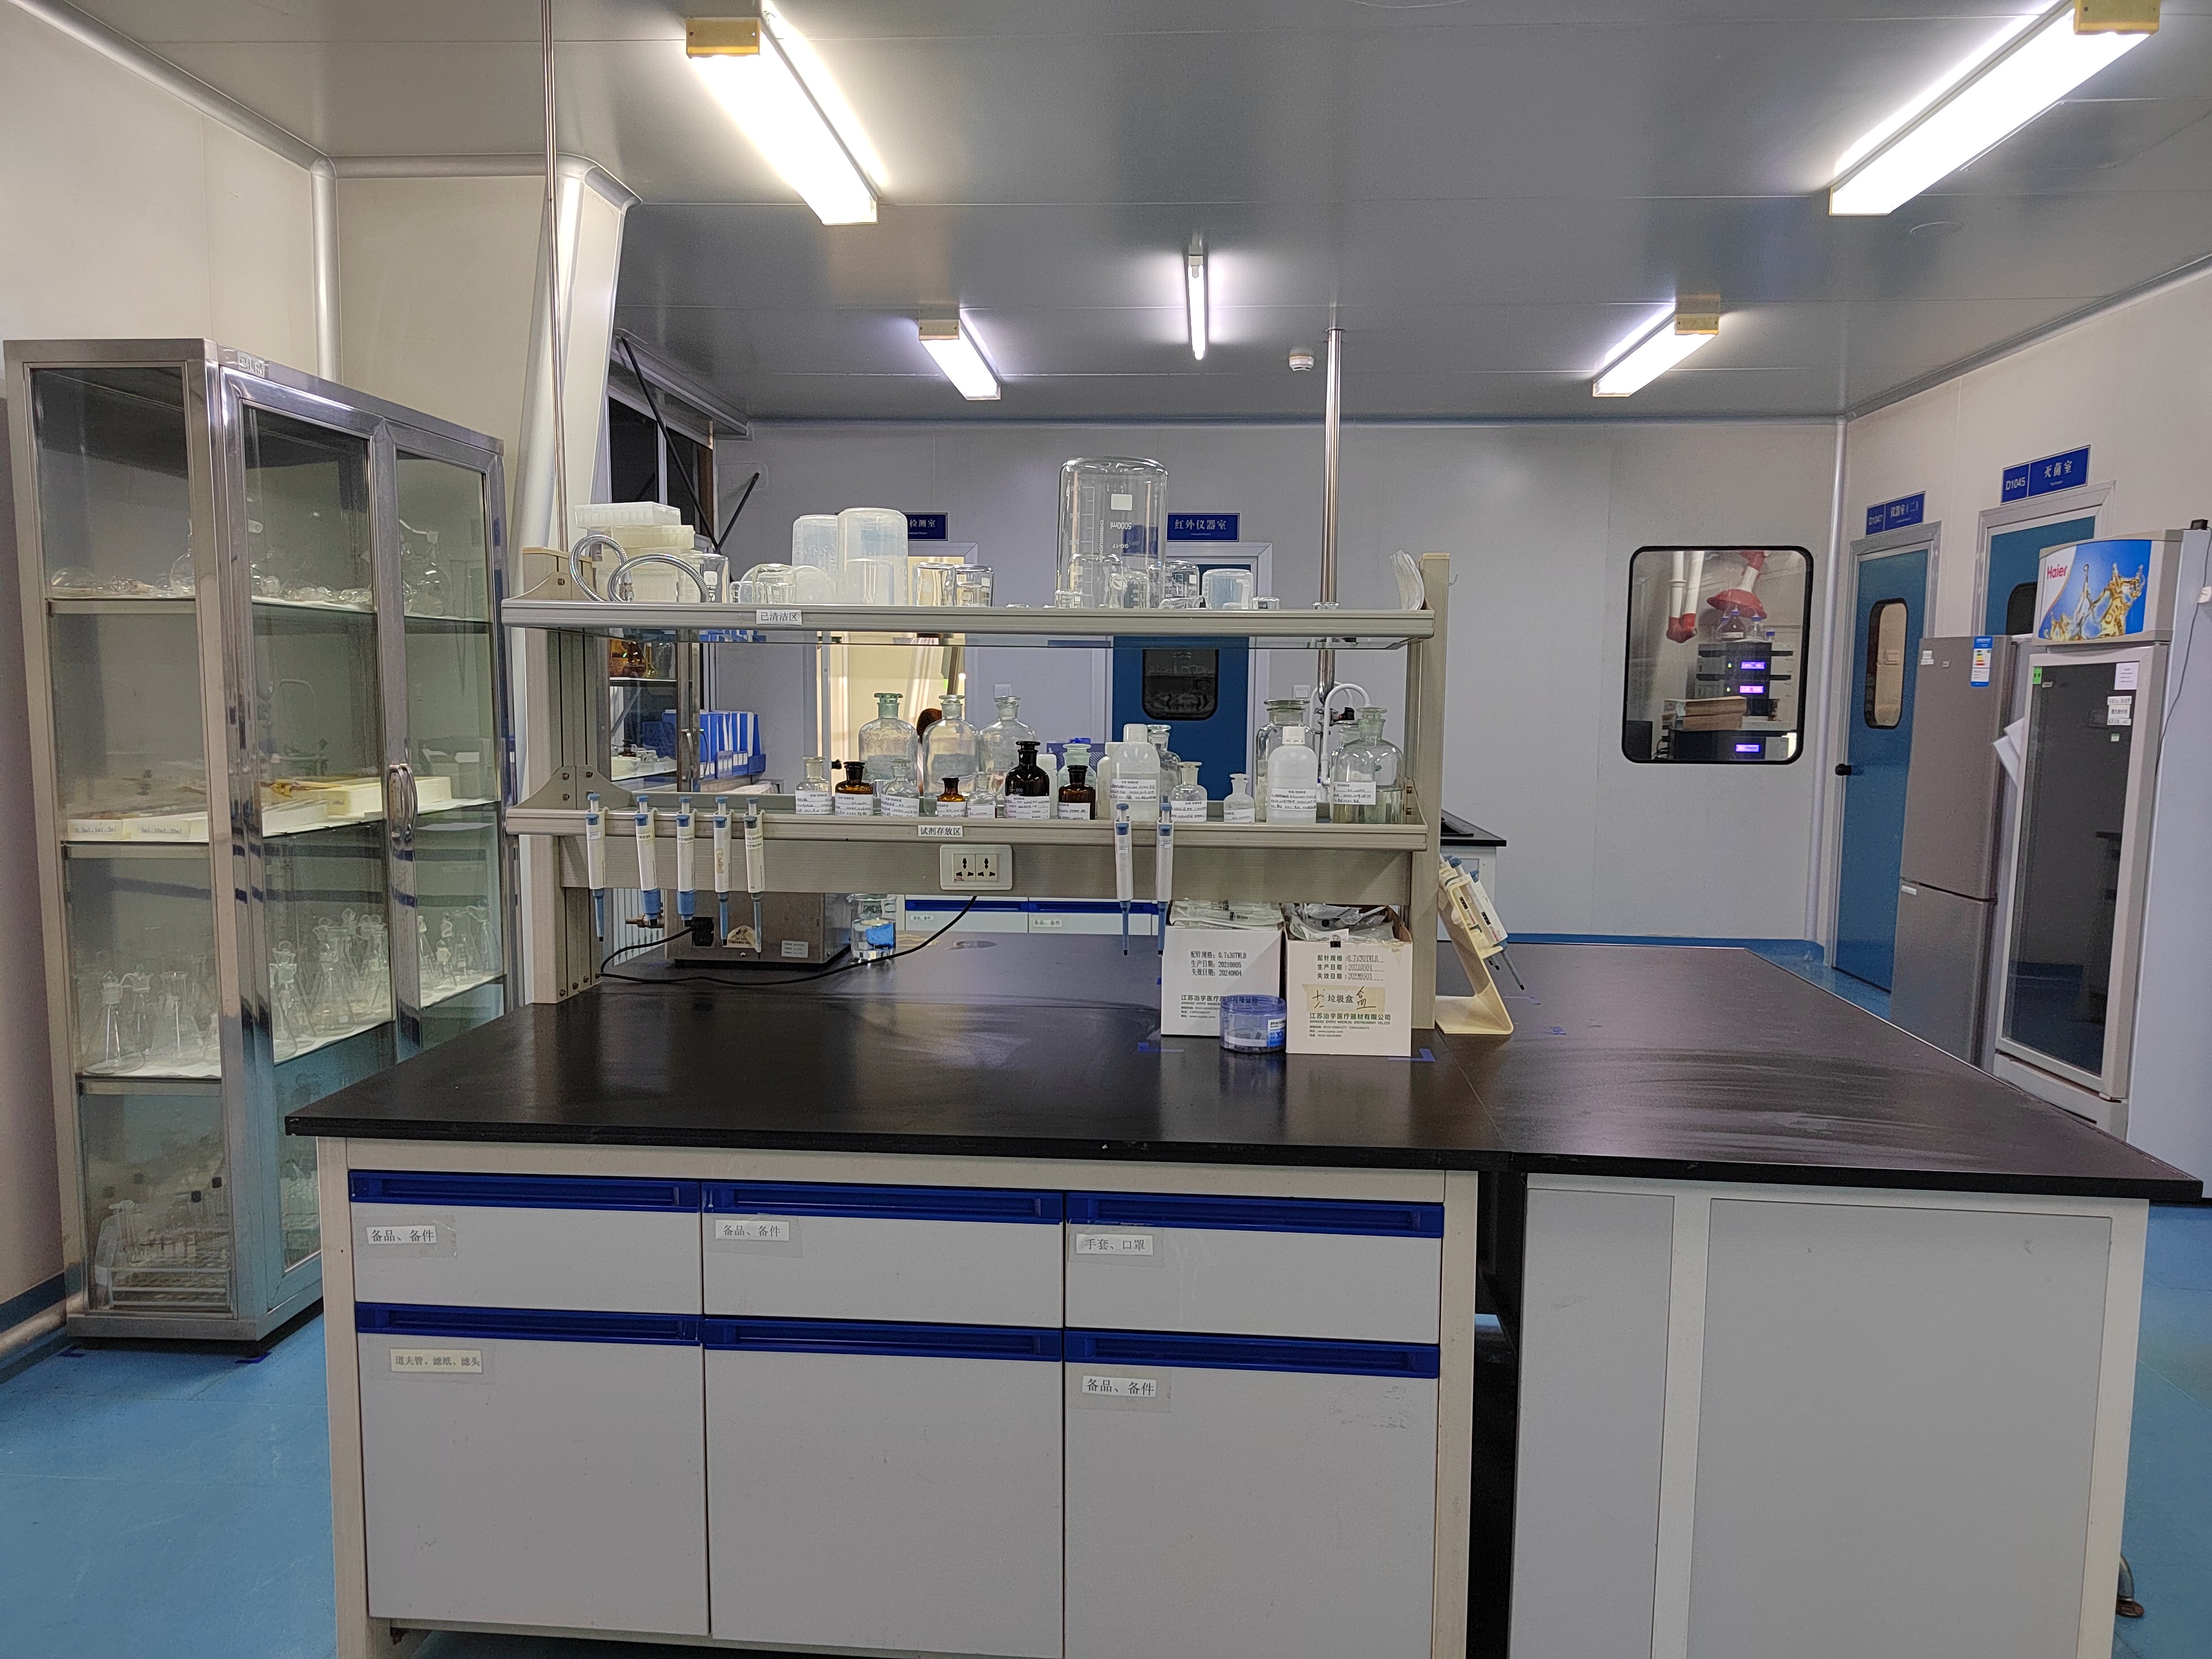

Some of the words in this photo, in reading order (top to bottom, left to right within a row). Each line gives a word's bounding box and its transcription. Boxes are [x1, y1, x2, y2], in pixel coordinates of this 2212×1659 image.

[2044, 460, 2073, 478] 灭菌室
[2006, 477, 2026, 491] D1045
[909, 519, 935, 528] 检测室
[1175, 519, 1227, 530] 红外仪器室
[2047, 564, 2068, 579] Haier
[761, 612, 798, 622] 已清洁区
[920, 827, 961, 836] 试剂存放区
[1328, 994, 1354, 1003] 垃圾盒
[371, 1229, 435, 1243] 备品、备件
[723, 1224, 781, 1237] 备品、备件
[1084, 1238, 1145, 1251] 手套、口罩
[1086, 1377, 1155, 1396] 备品、备件
